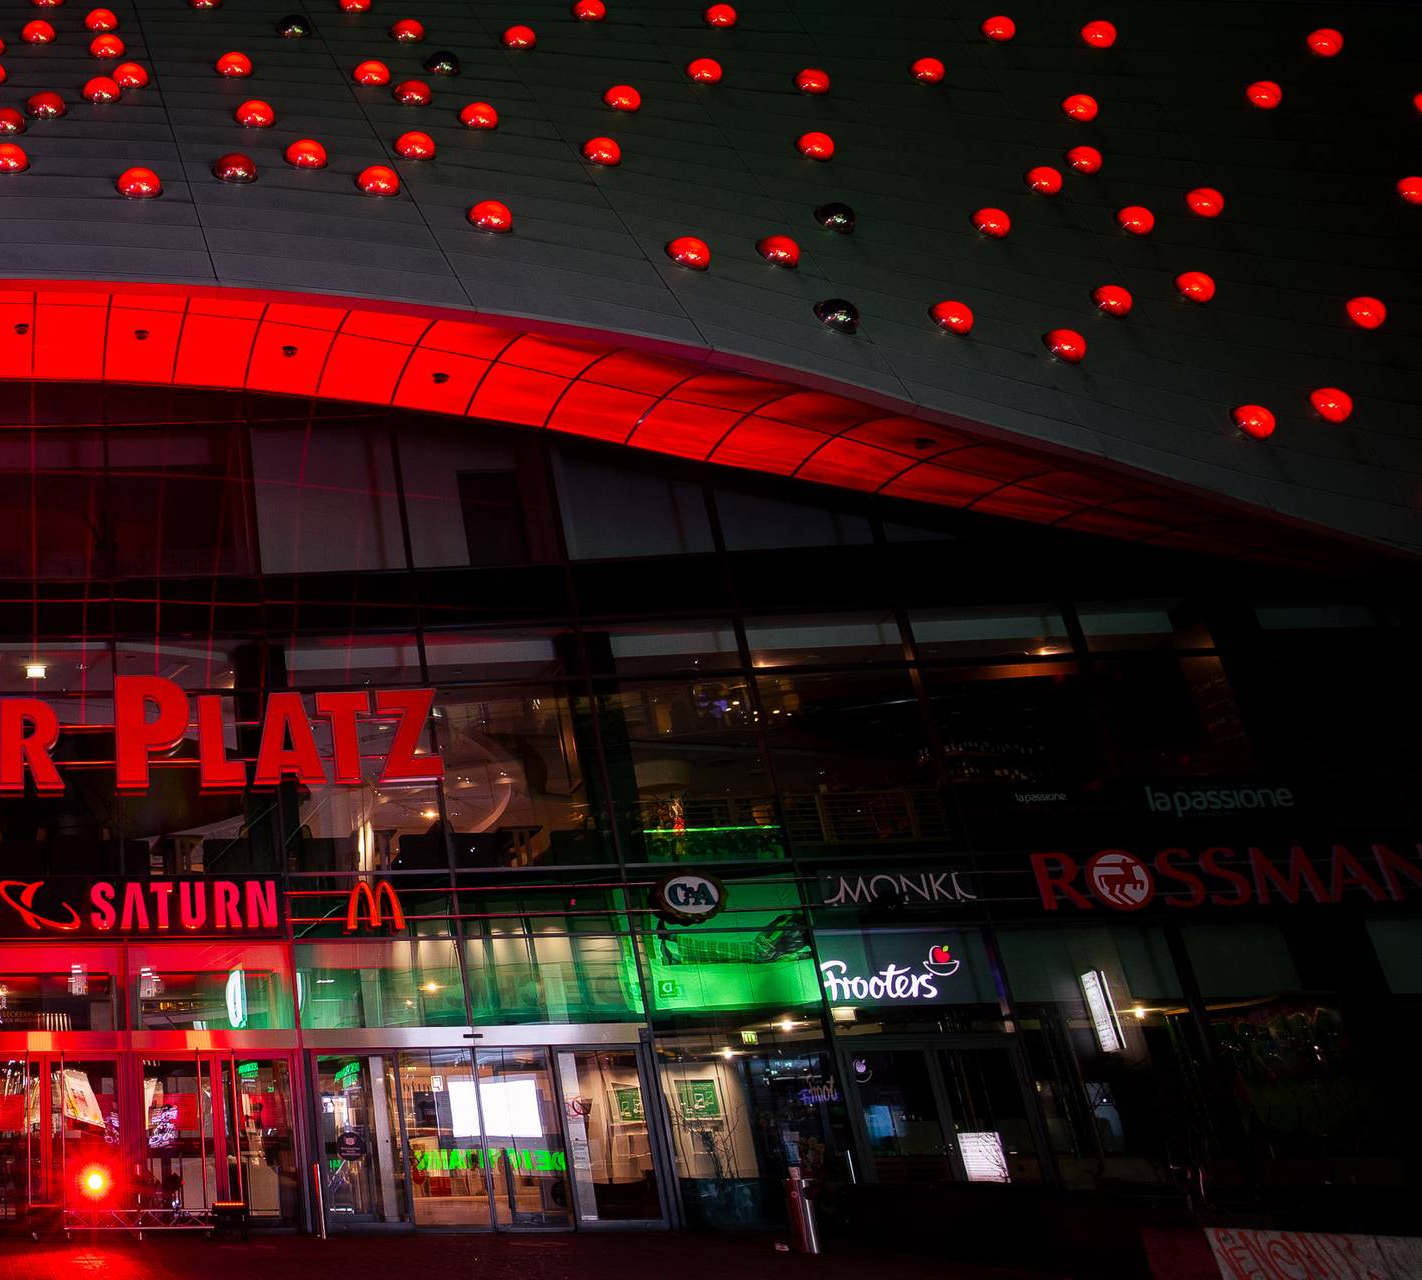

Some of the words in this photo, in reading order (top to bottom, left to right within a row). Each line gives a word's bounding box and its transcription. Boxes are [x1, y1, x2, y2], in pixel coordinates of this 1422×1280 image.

[115, 676, 444, 796] PLATZ
[90, 880, 279, 931] SATURN
[667, 882, 716, 906] C&A
[820, 959, 939, 1001] Frooters
